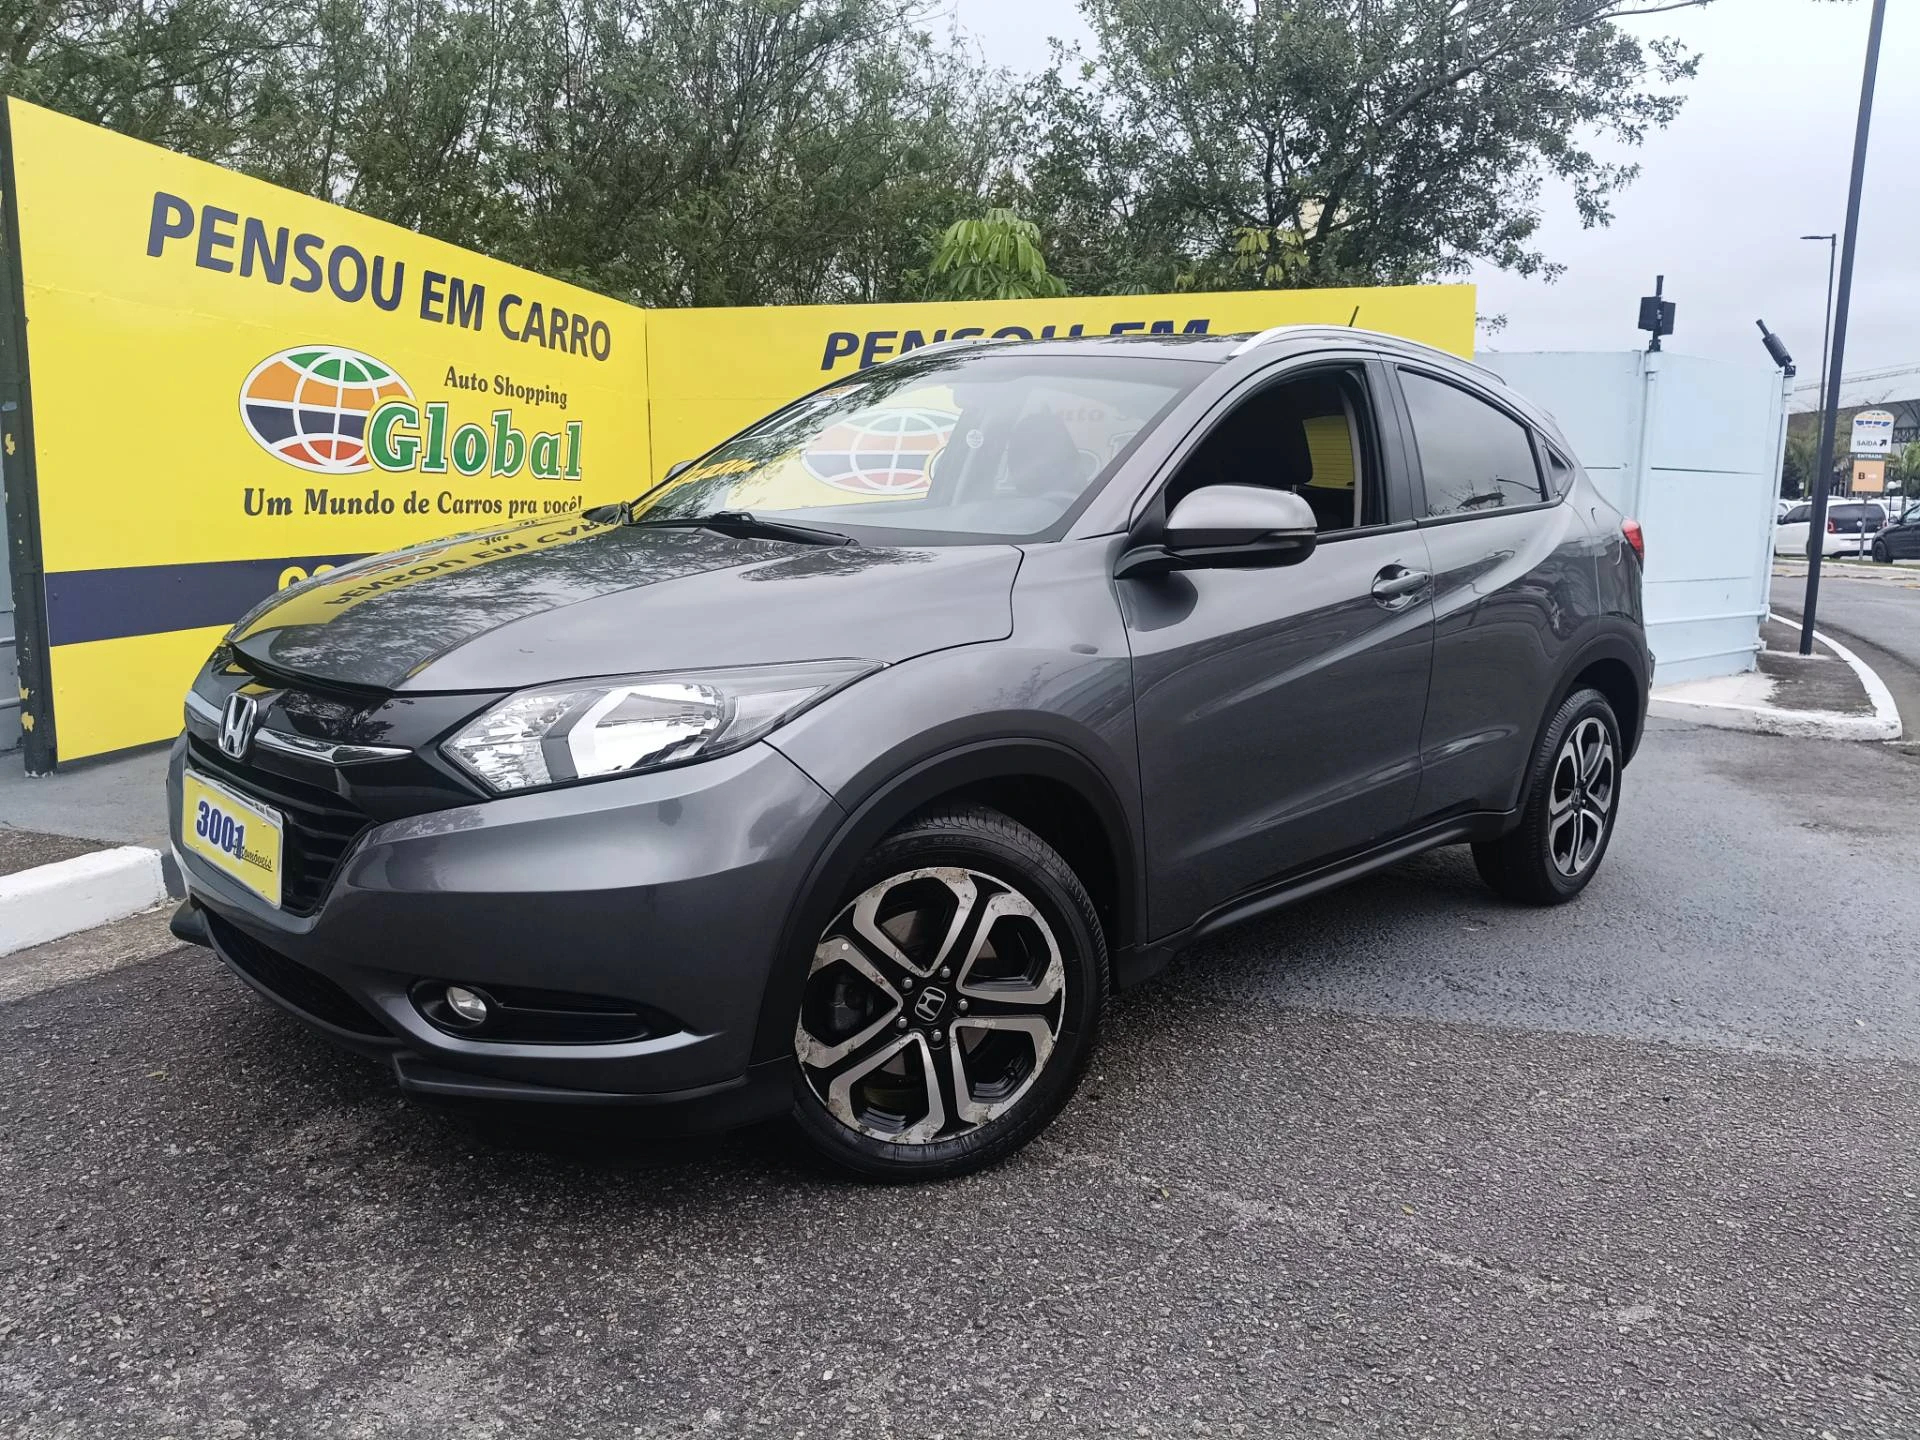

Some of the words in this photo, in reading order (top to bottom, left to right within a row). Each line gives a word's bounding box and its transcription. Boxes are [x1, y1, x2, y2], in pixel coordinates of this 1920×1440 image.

[146, 190, 405, 312] PENSOU
[419, 269, 486, 332] EM
[498, 293, 611, 362] CARRO
[443, 365, 488, 393] Auto
[493, 374, 568, 410] Shopping
[367, 400, 584, 482] Global
[1858, 472, 1865, 480] B
[243, 487, 293, 516] Um
[303, 488, 395, 515] Mundo
[403, 490, 430, 515] de
[437, 490, 503, 515] Carros
[507, 499, 538, 519] pra
[543, 495, 583, 515] você!
[196, 800, 245, 860] 3001
